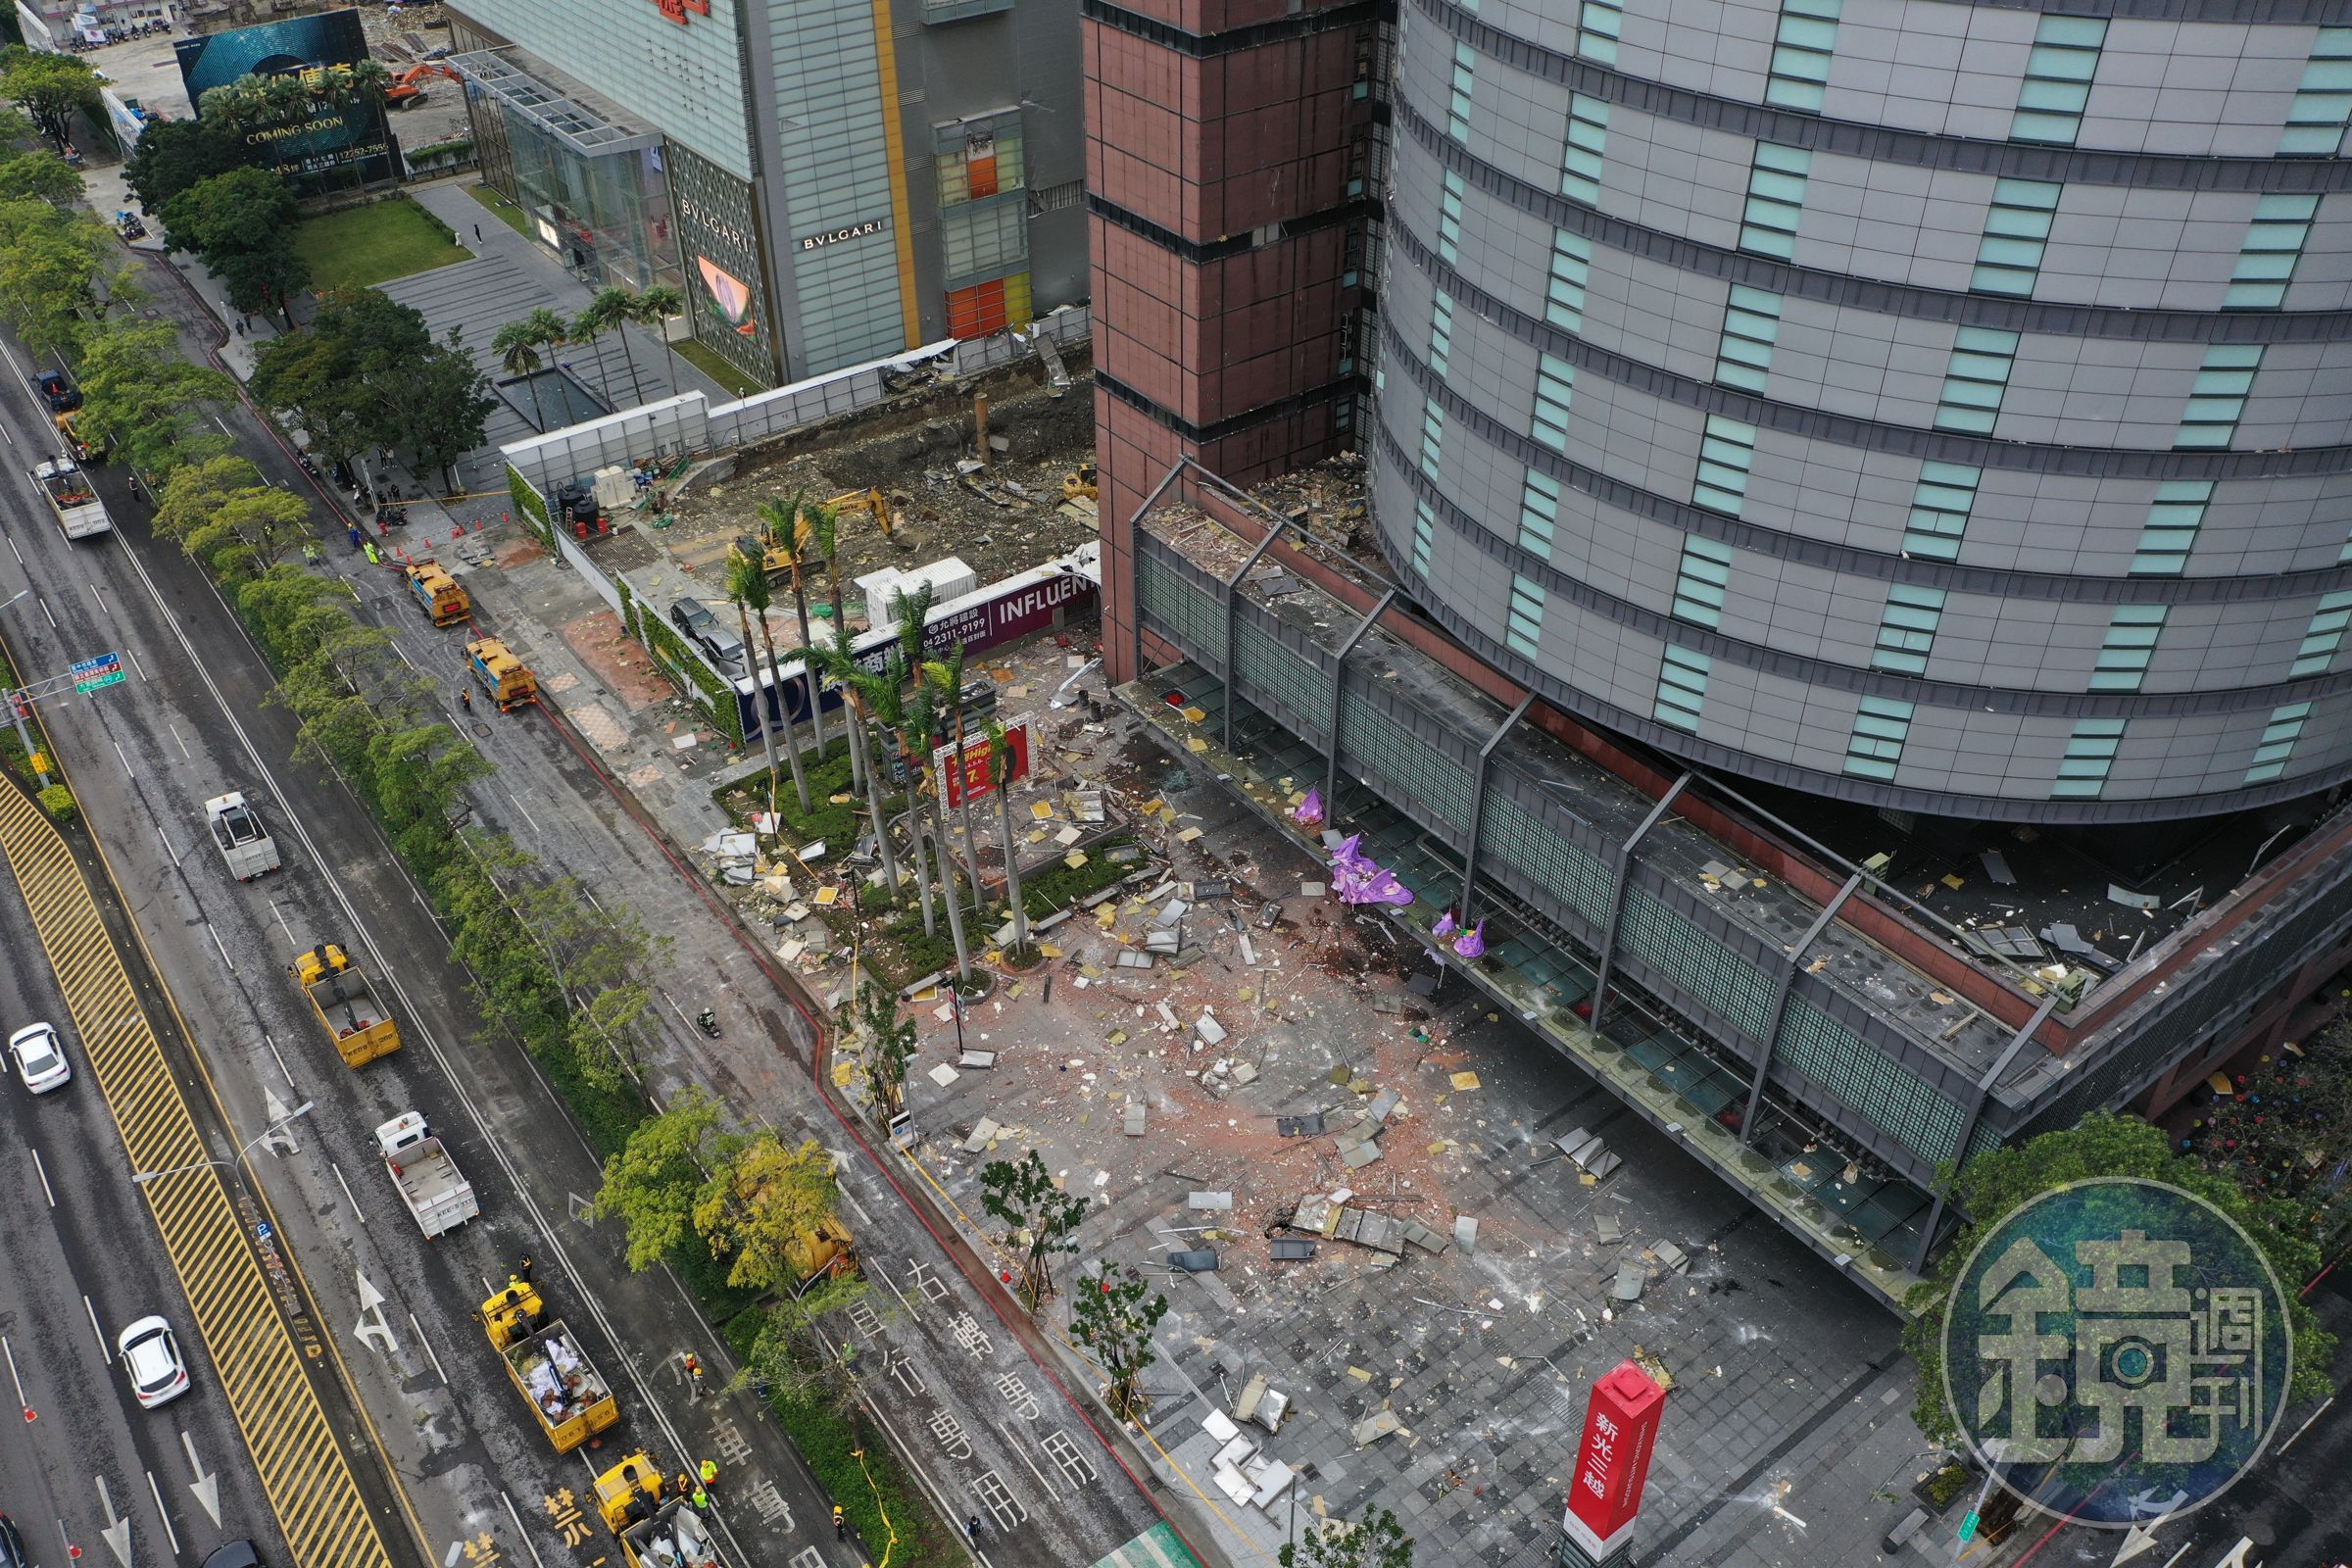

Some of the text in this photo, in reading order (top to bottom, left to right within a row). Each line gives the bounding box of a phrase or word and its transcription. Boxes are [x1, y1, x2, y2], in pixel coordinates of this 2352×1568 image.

[246, 116, 344, 146] COMING SOON
[682, 198, 749, 253] BVLGARI
[804, 220, 882, 250] BVLGARI
[939, 608, 979, 631] 允將建設
[999, 574, 1096, 625] INFLUEN
[923, 617, 986, 649] 04 2311-9199
[906, 1258, 1098, 1490] 右轉專用
[1582, 1411, 1619, 1500] 新光三越
[544, 1487, 600, 1560] 禁
